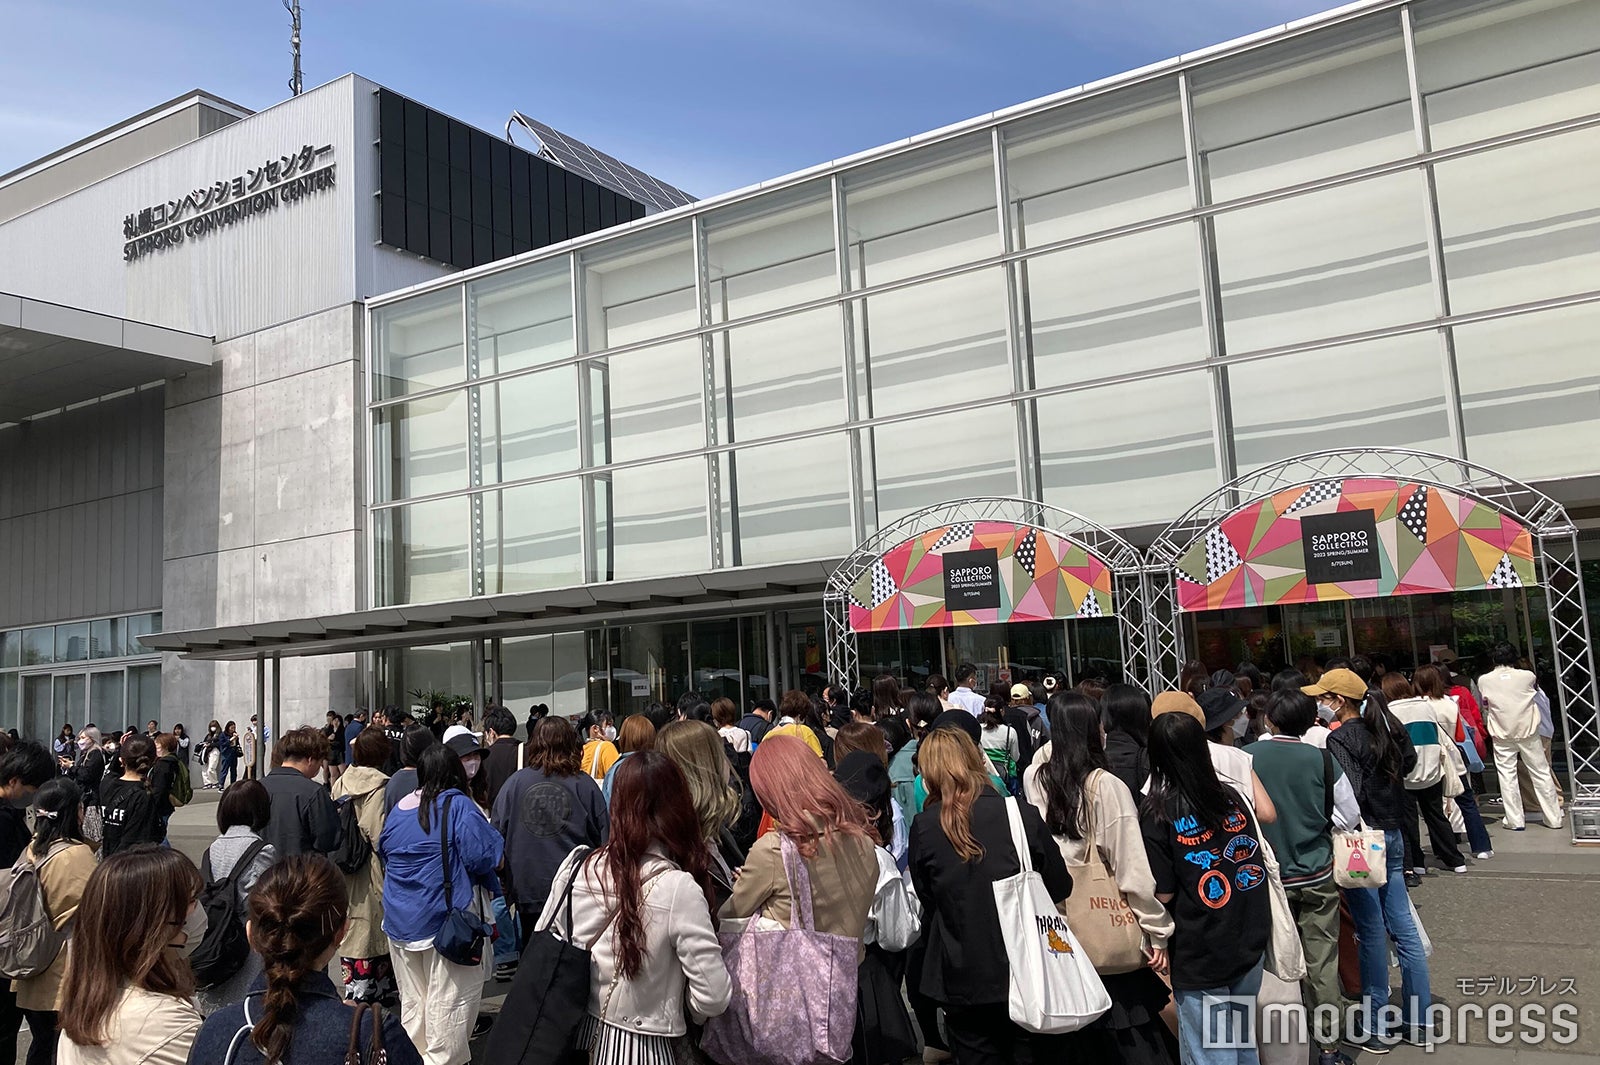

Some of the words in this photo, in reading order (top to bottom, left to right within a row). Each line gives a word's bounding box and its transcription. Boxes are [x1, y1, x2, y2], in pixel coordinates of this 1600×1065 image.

[123, 144, 333, 239] 札幌コンベンションセンター
[123, 222, 183, 261] SAPPORO
[185, 188, 279, 238] CONVENTION
[280, 166, 336, 203] CENTER
[1311, 530, 1368, 545] SAPPORO
[1312, 539, 1369, 551] COLLECTION
[950, 566, 992, 577] SAPPORO
[950, 573, 992, 583] COLLECTION
[1176, 834, 1202, 846] SWEET
[1345, 838, 1366, 851] LIKE
